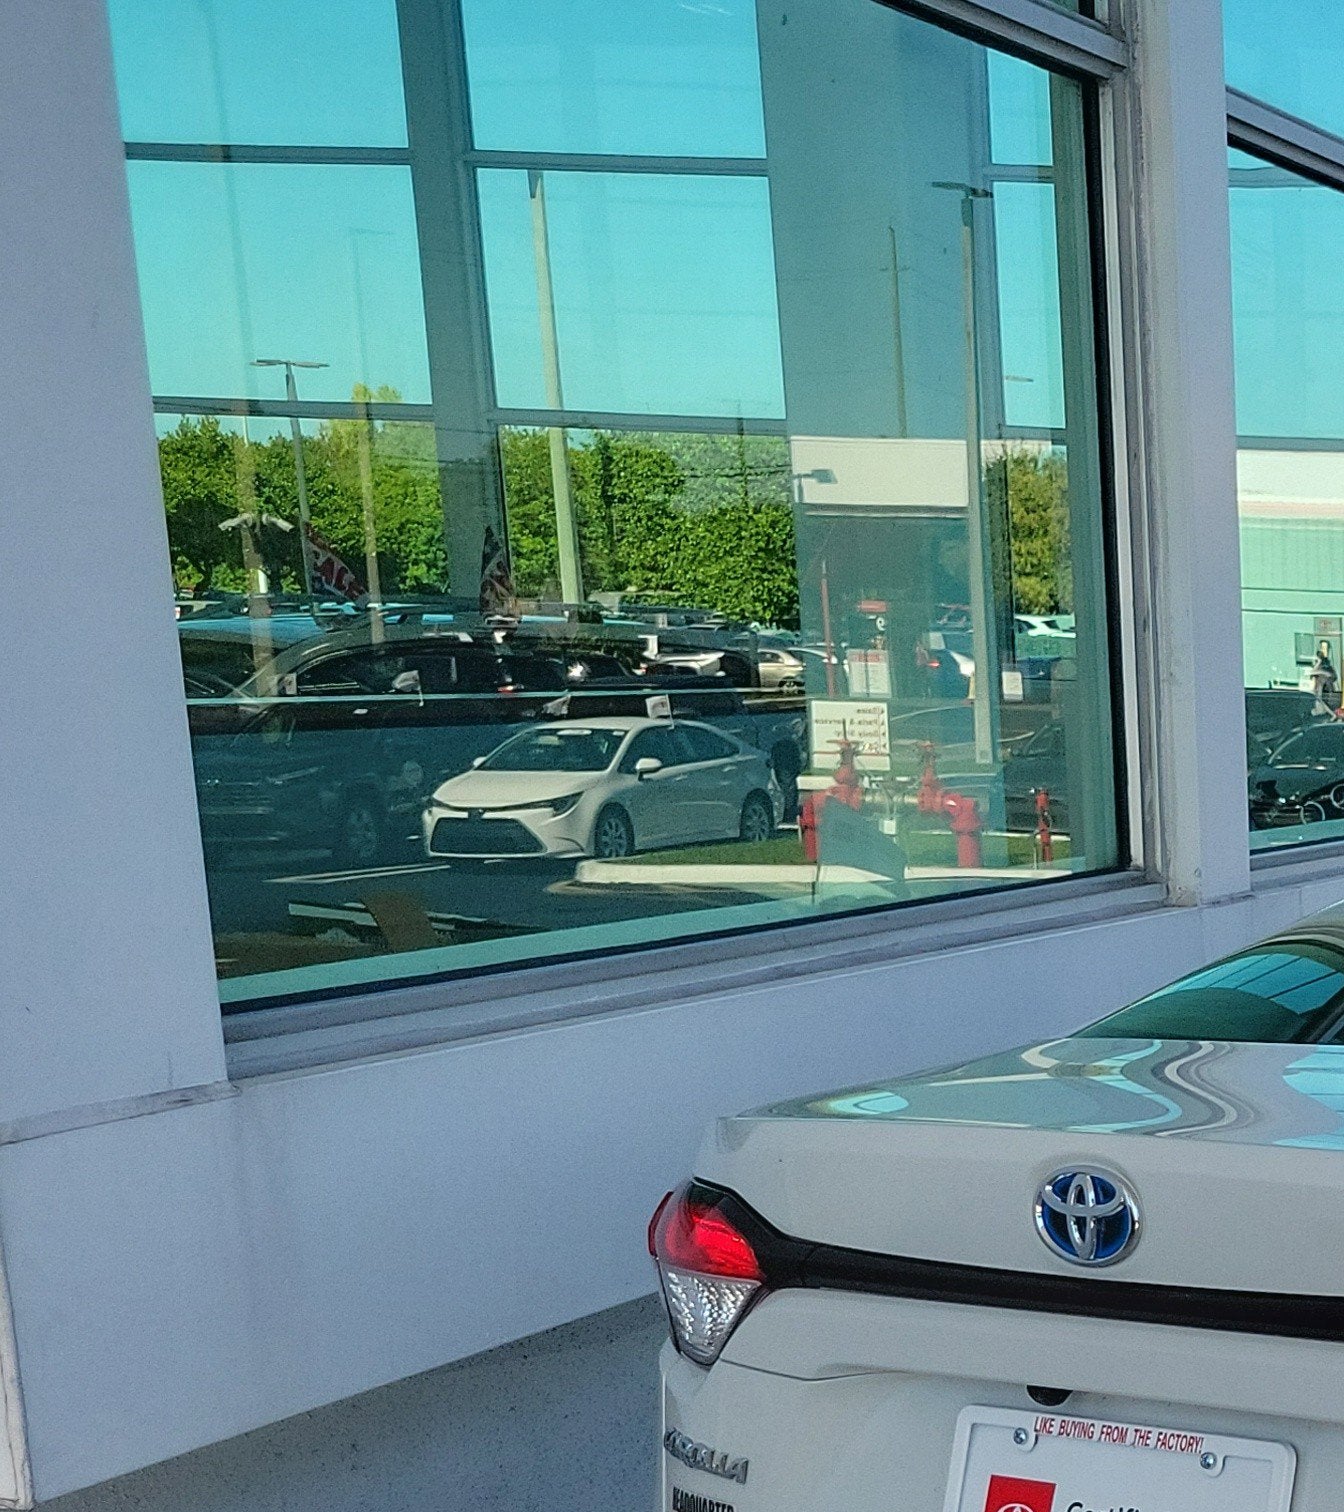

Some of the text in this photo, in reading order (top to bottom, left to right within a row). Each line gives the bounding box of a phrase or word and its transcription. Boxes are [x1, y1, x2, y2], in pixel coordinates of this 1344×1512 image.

[1034, 1416, 1205, 1454] LIKE BUYING FROM THE FACTORY!
